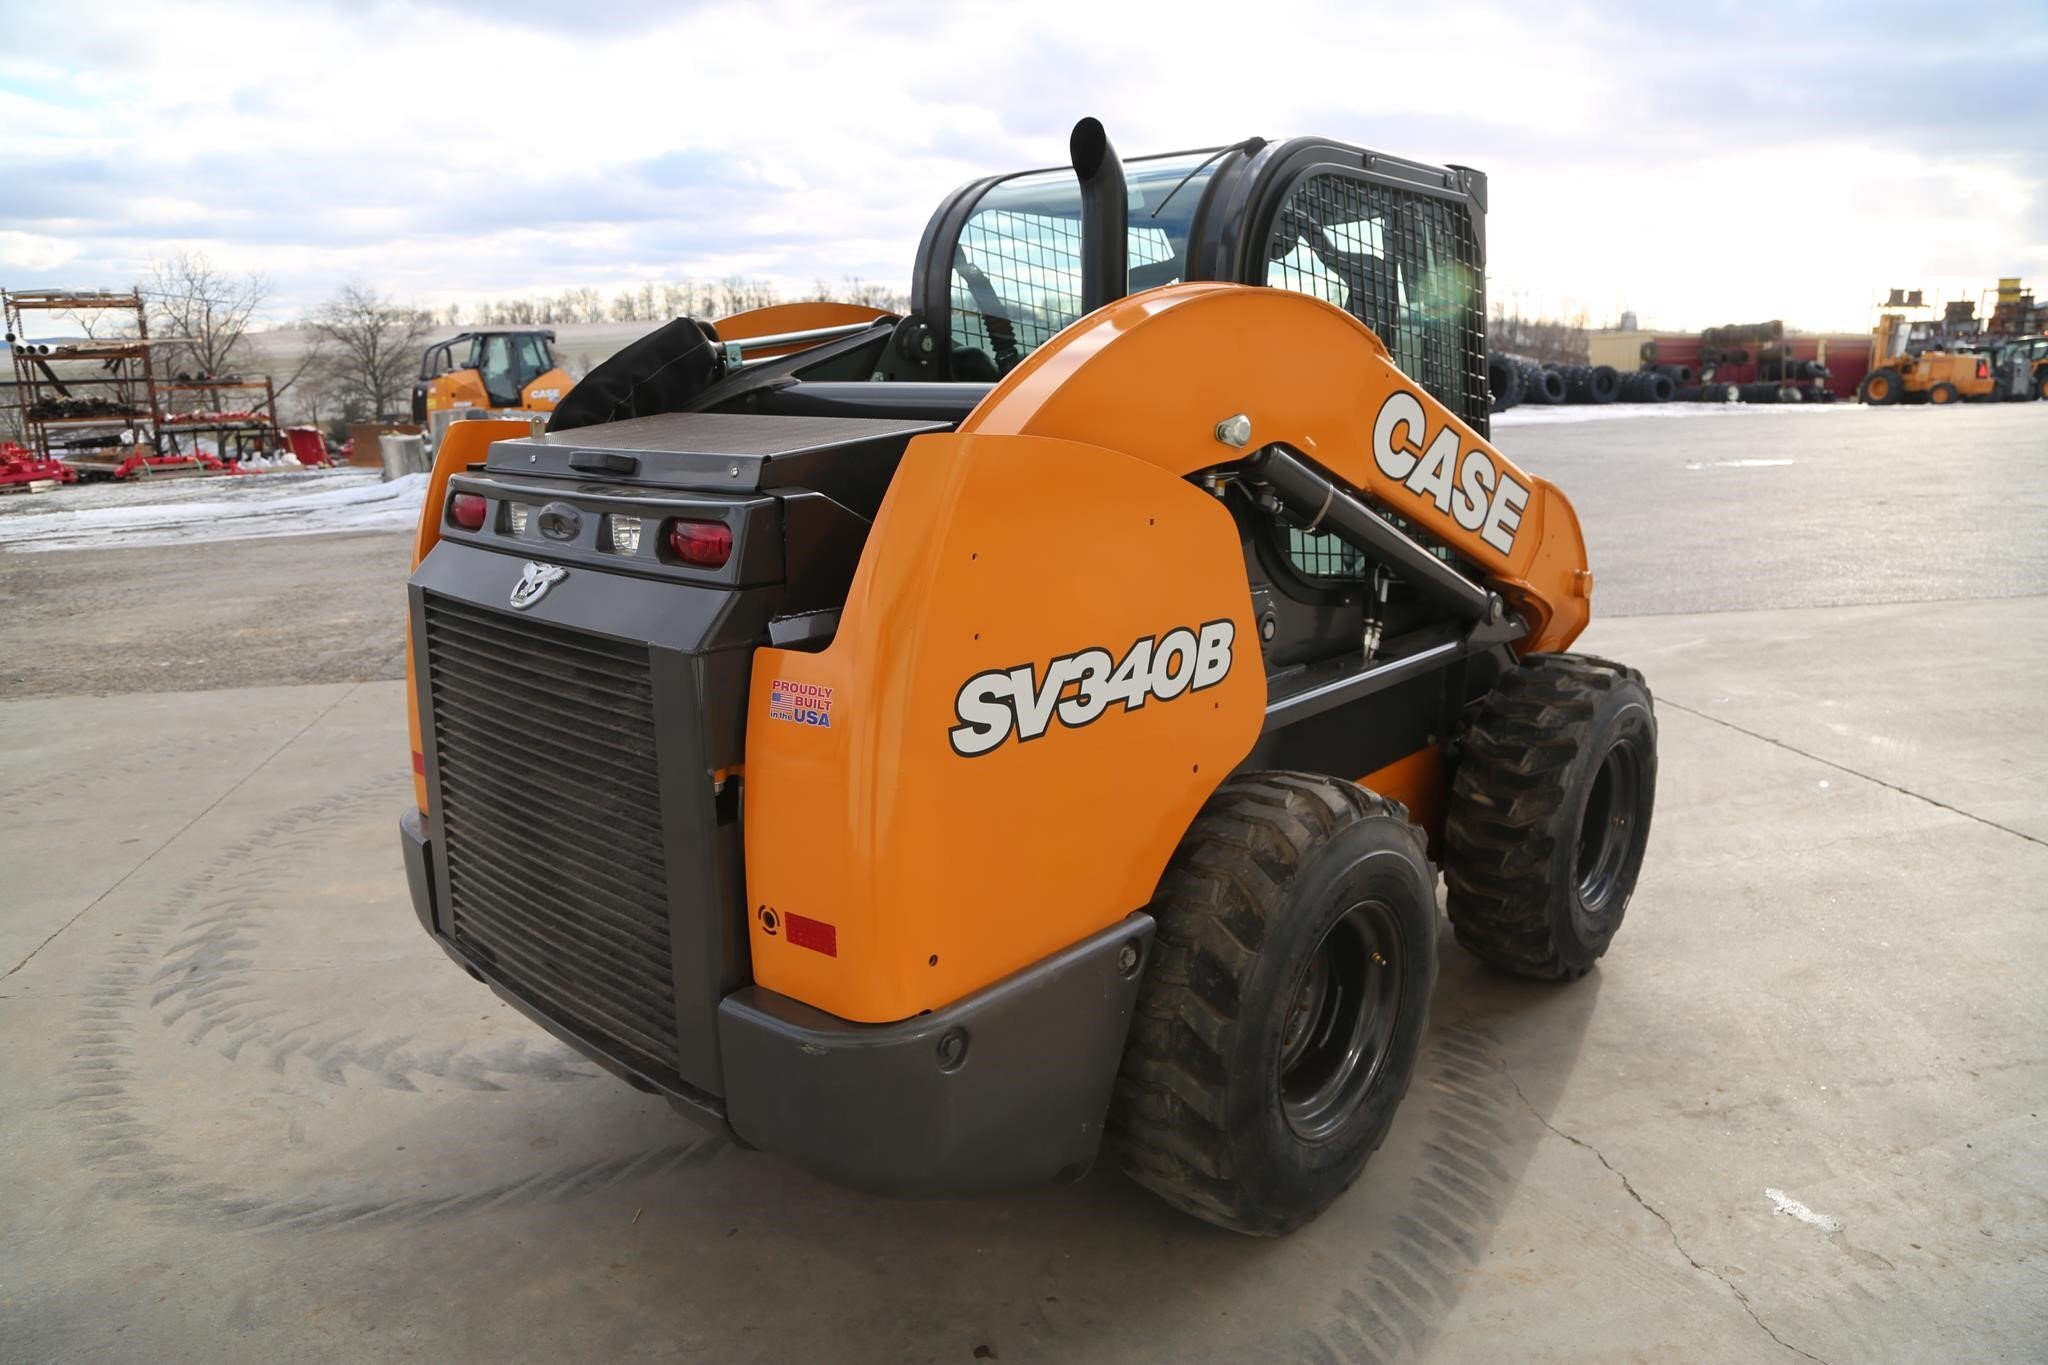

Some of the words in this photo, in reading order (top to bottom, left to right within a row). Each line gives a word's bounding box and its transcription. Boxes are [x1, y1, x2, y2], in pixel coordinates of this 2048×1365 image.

[1372, 390, 1531, 557] CASE
[772, 680, 832, 698] PROUDLY
[949, 618, 1235, 757] SV340B
[795, 696, 832, 711] BUILT
[779, 712, 792, 721] the
[794, 708, 830, 727] USA
